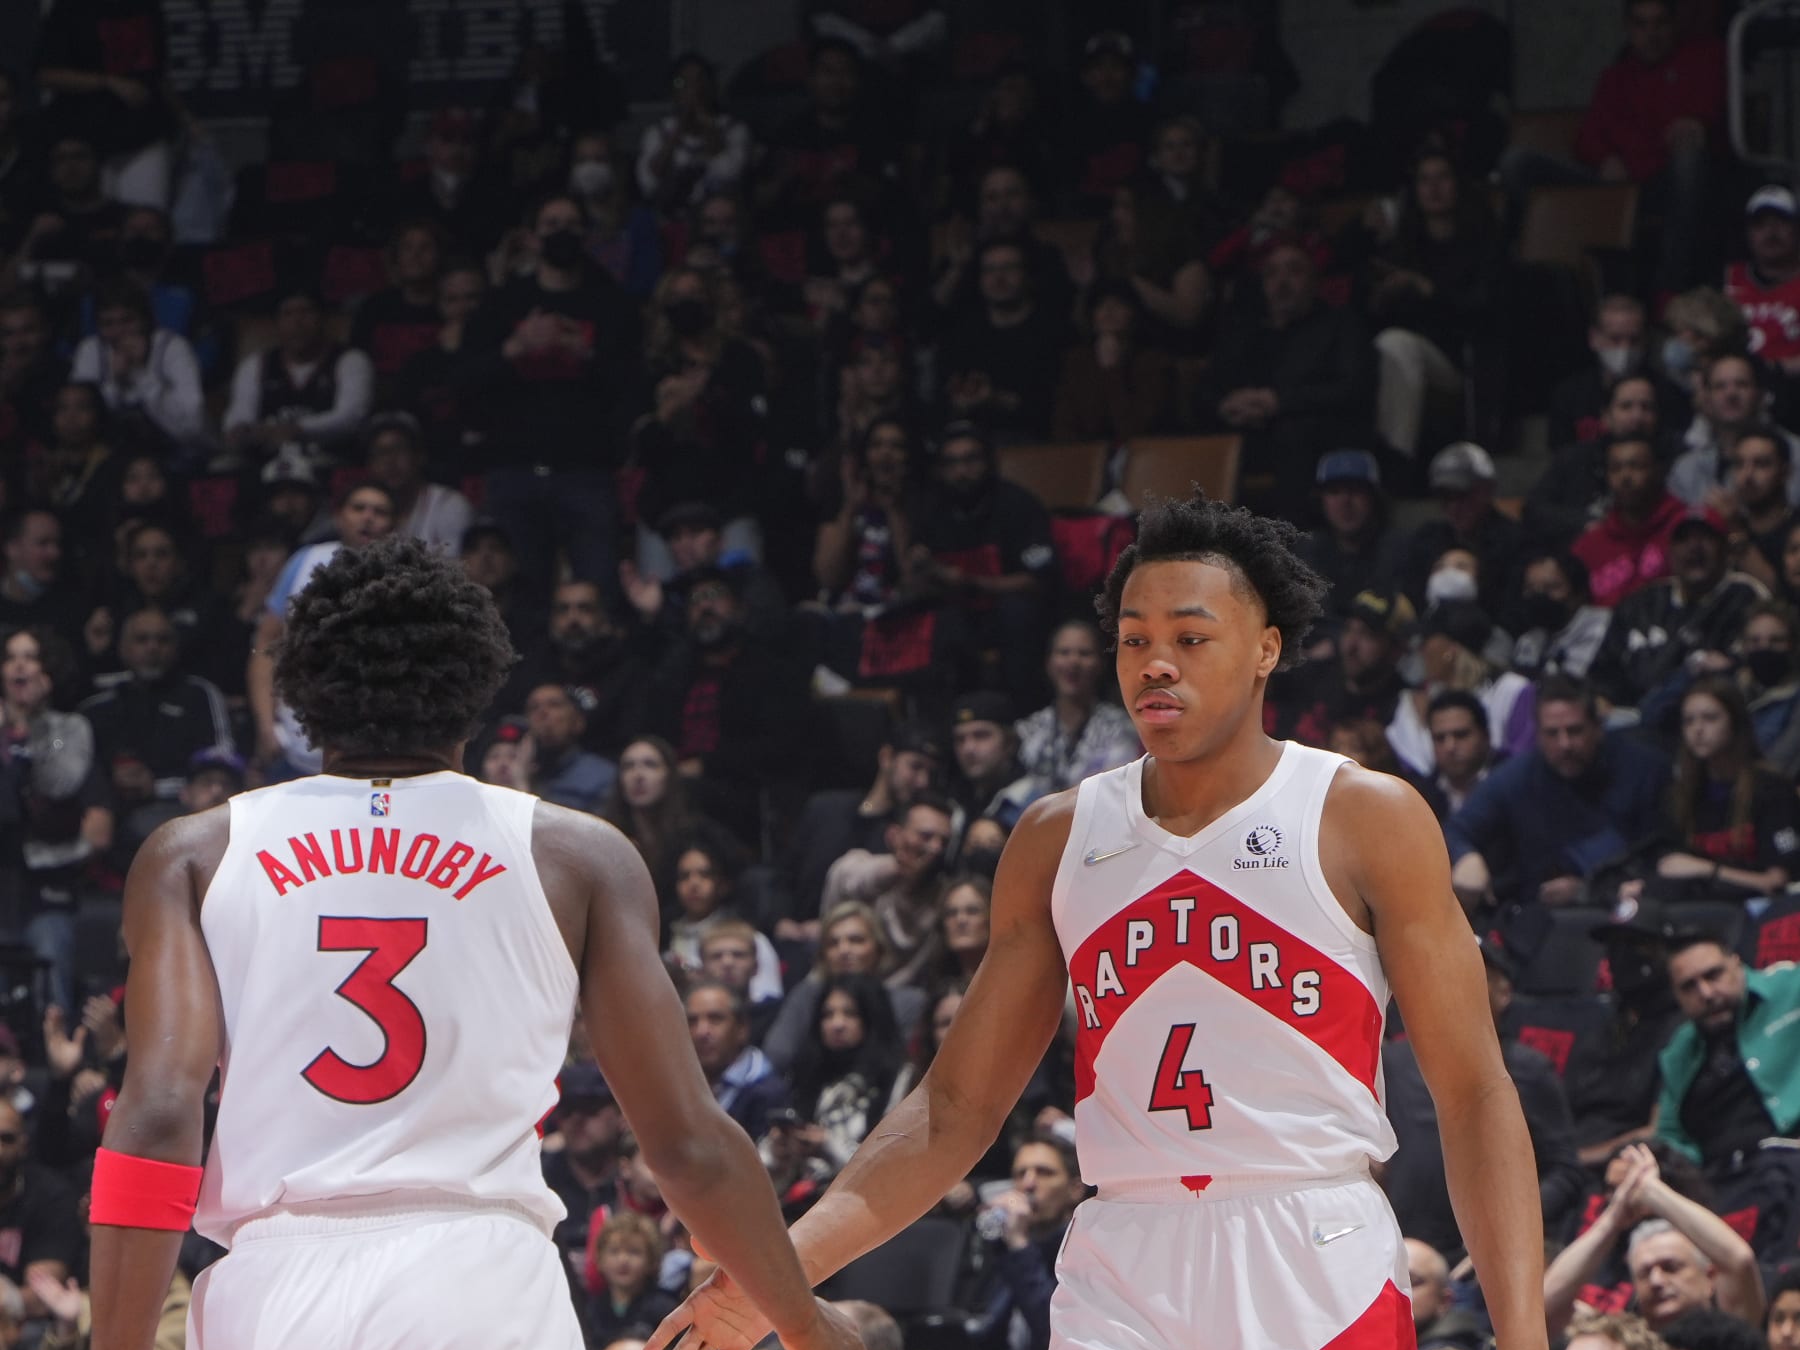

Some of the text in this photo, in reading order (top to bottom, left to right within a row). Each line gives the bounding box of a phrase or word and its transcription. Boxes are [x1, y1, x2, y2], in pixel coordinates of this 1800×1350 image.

[161, 0, 306, 89] BM
[255, 826, 507, 902] ANUNOBY
[1233, 856, 1289, 870] Sun Life
[300, 915, 429, 1105] 3
[1076, 897, 1321, 1029] RAPTORS
[1148, 1023, 1213, 1130] 4
